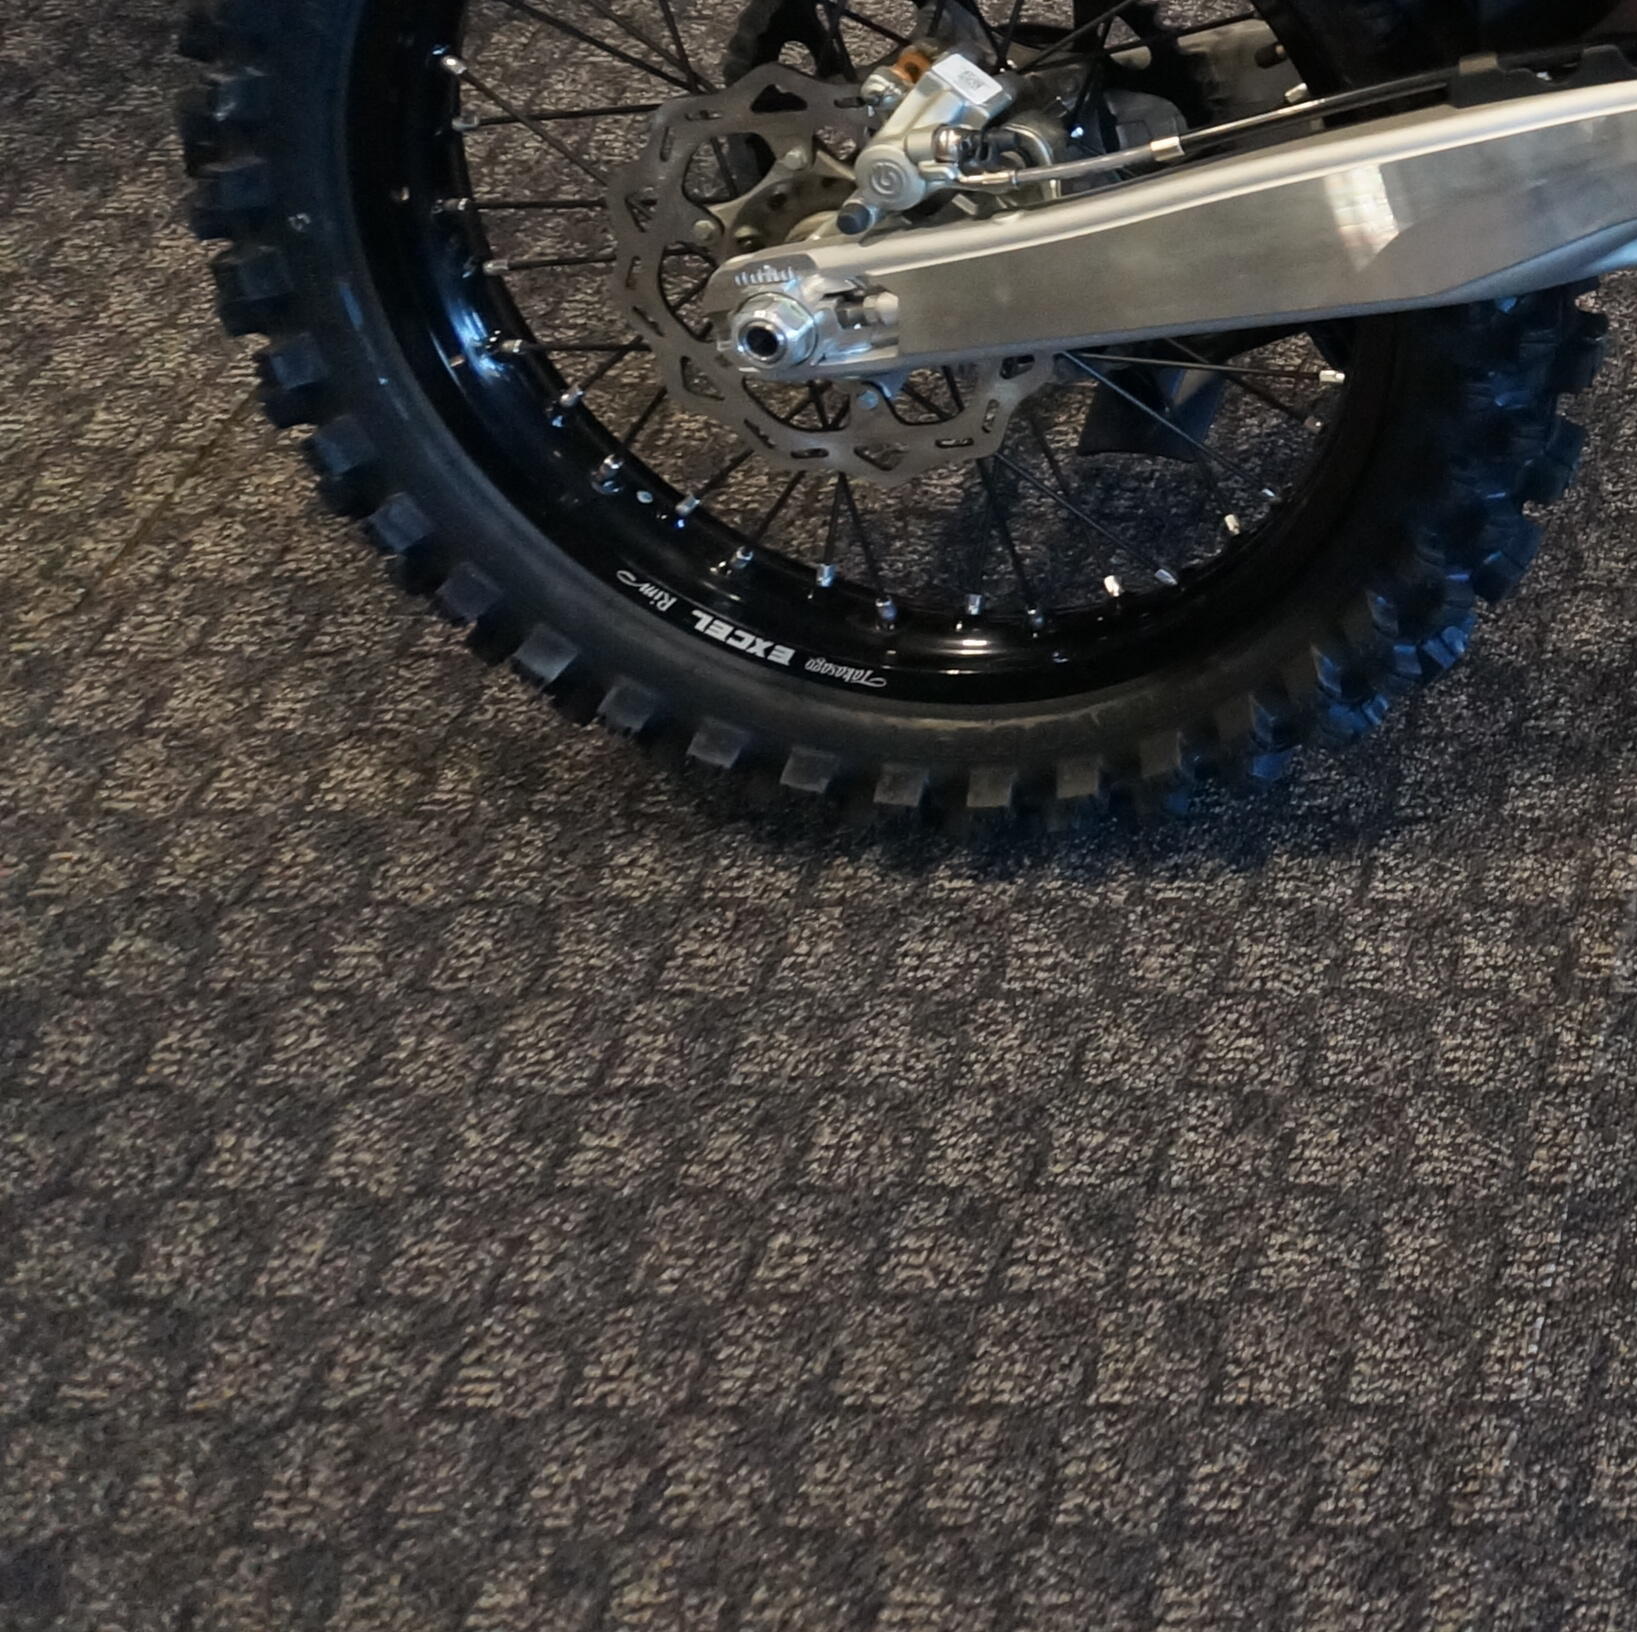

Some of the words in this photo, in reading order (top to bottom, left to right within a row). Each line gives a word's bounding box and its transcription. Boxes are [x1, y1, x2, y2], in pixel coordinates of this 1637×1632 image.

[616, 569, 678, 613] Rim
[692, 609, 796, 667] EXCEL
[805, 656, 888, 689] Takasago
